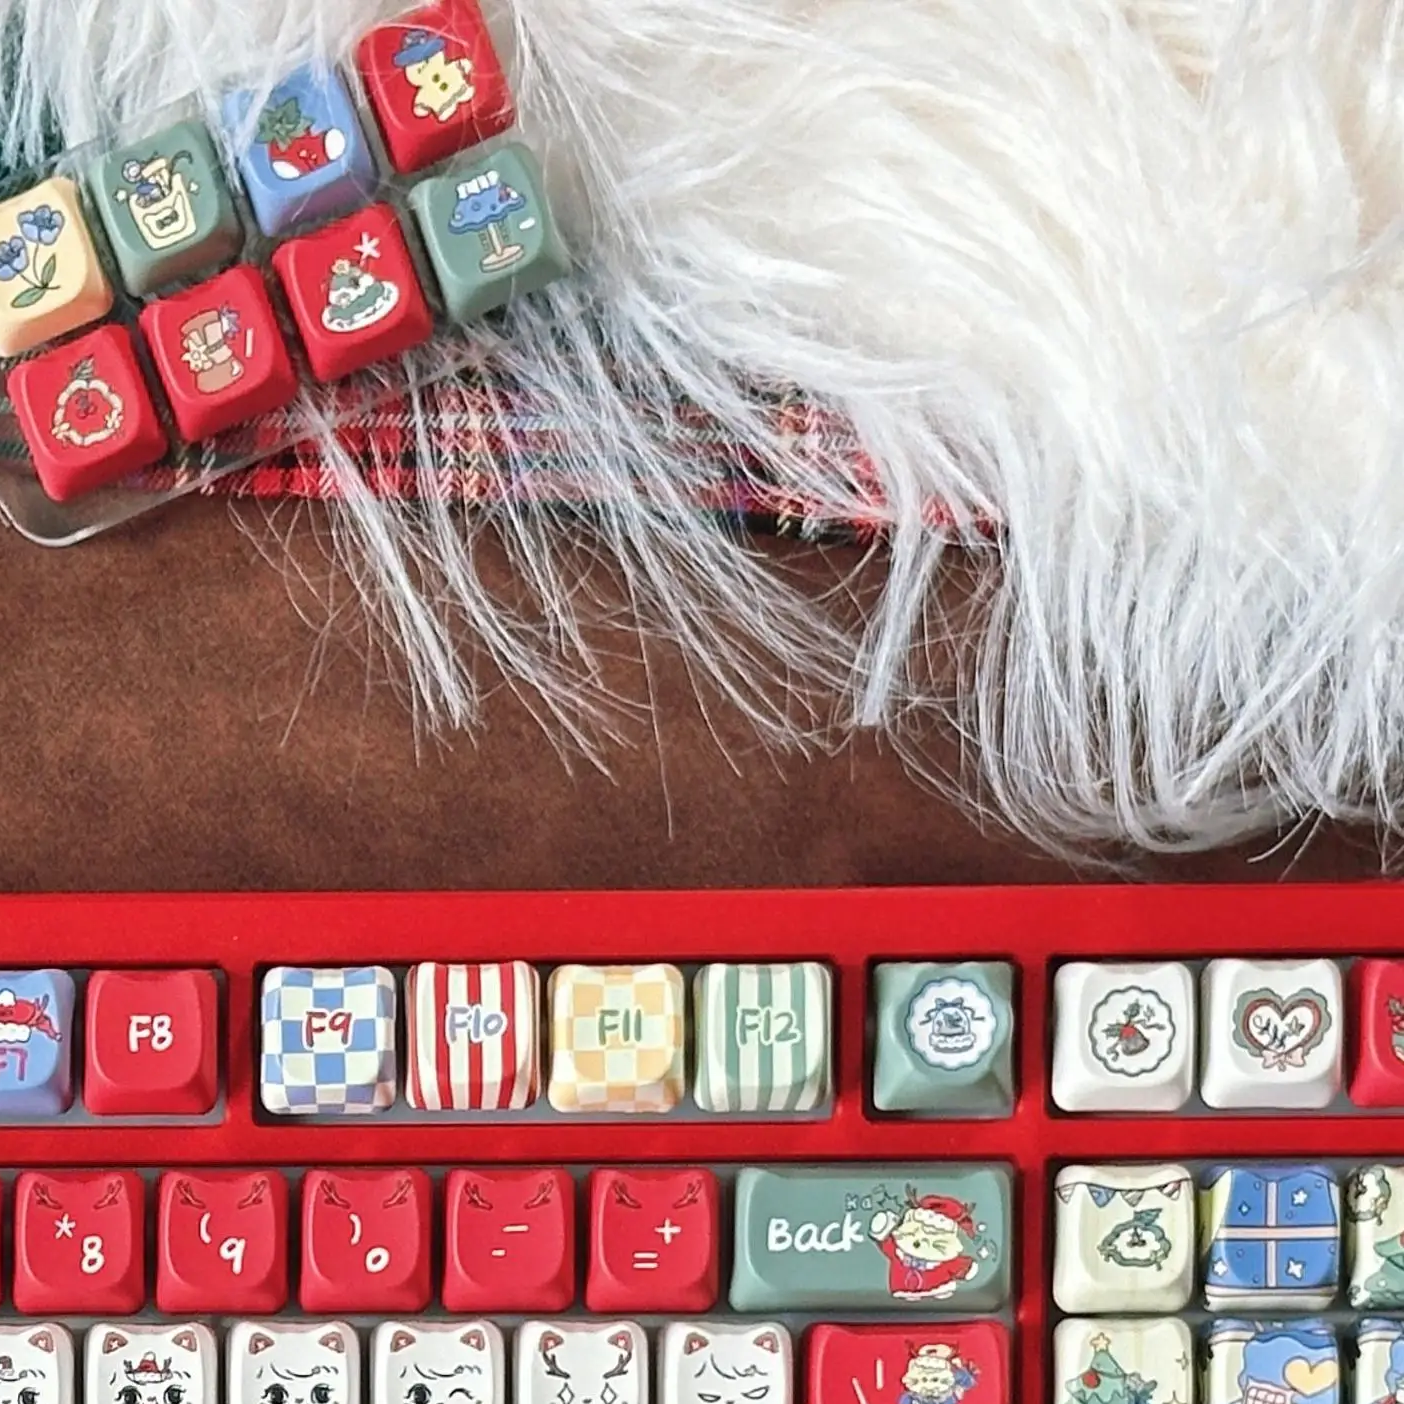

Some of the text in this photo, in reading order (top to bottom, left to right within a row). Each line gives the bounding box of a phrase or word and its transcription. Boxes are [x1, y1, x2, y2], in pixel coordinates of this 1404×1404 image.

[129, 1015, 173, 1052] F8
[305, 1012, 352, 1047] F9
[447, 1006, 504, 1043] F10
[597, 1009, 643, 1045] F11
[739, 1008, 799, 1043] F12
[768, 1212, 864, 1252] Back
[81, 1236, 105, 1274] 8
[220, 1237, 246, 1274] 9
[633, 1252, 658, 1269] =
